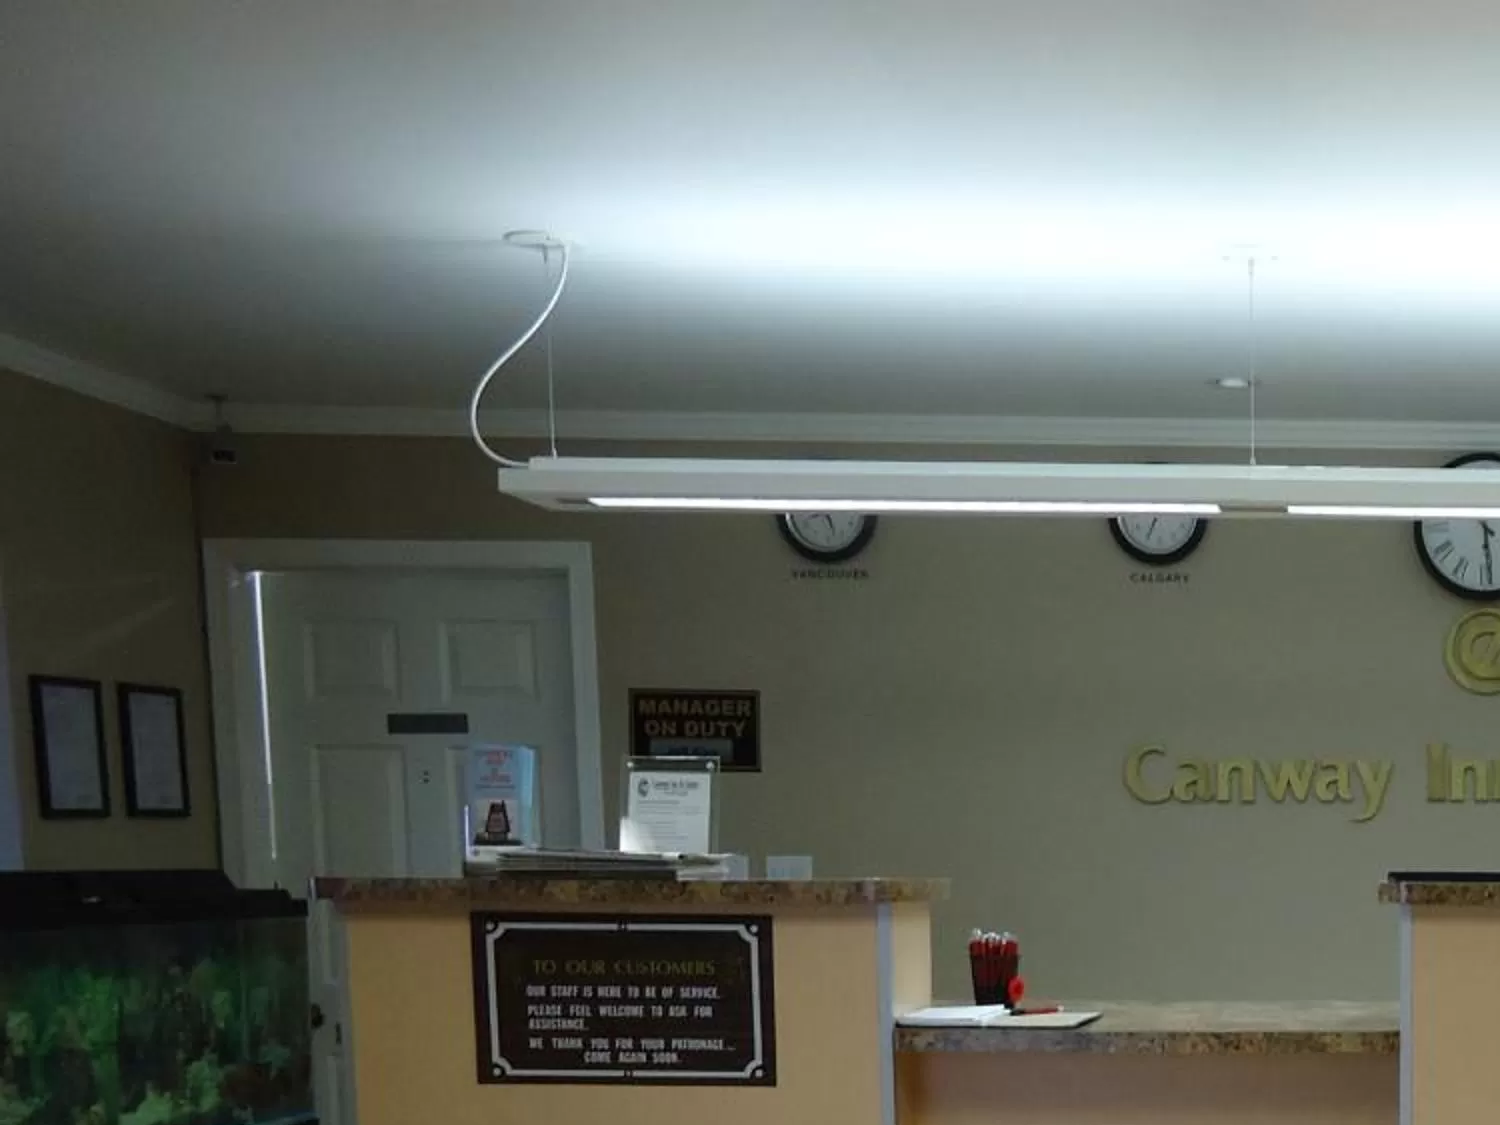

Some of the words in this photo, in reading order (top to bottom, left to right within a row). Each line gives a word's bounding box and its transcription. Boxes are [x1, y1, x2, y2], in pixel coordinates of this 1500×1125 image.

[1129, 572, 1189, 583] CALGARY
[638, 699, 751, 717] MANAGER
[644, 719, 677, 736] ON
[684, 720, 746, 737] DUTY
[1122, 743, 1395, 823] Canway
[532, 959, 557, 975] TO
[565, 959, 606, 975] OUR
[613, 959, 716, 976] CUSTOMERS
[526, 985, 546, 997] OUR
[549, 985, 580, 997] STAFF
[583, 985, 593, 997] IS
[597, 985, 621, 998] HERE
[627, 985, 640, 998] TO
[644, 985, 656, 998] BE
[661, 985, 674, 999] OF
[527, 1004, 562, 1017] PLEASE
[569, 1005, 592, 1017] FEEL
[598, 1005, 644, 1018] WELCOME
[651, 1005, 663, 1017] TO
[668, 1005, 687, 1017] ASK
[693, 1005, 713, 1018] FOR
[529, 1037, 543, 1050] WE
[551, 1037, 583, 1050] THANK
[591, 1037, 609, 1050] YOU
[615, 1037, 633, 1050] FOR
[640, 1038, 665, 1050] YOUR
[584, 1051, 611, 1064] COME
[618, 1051, 647, 1064] AGAIN
